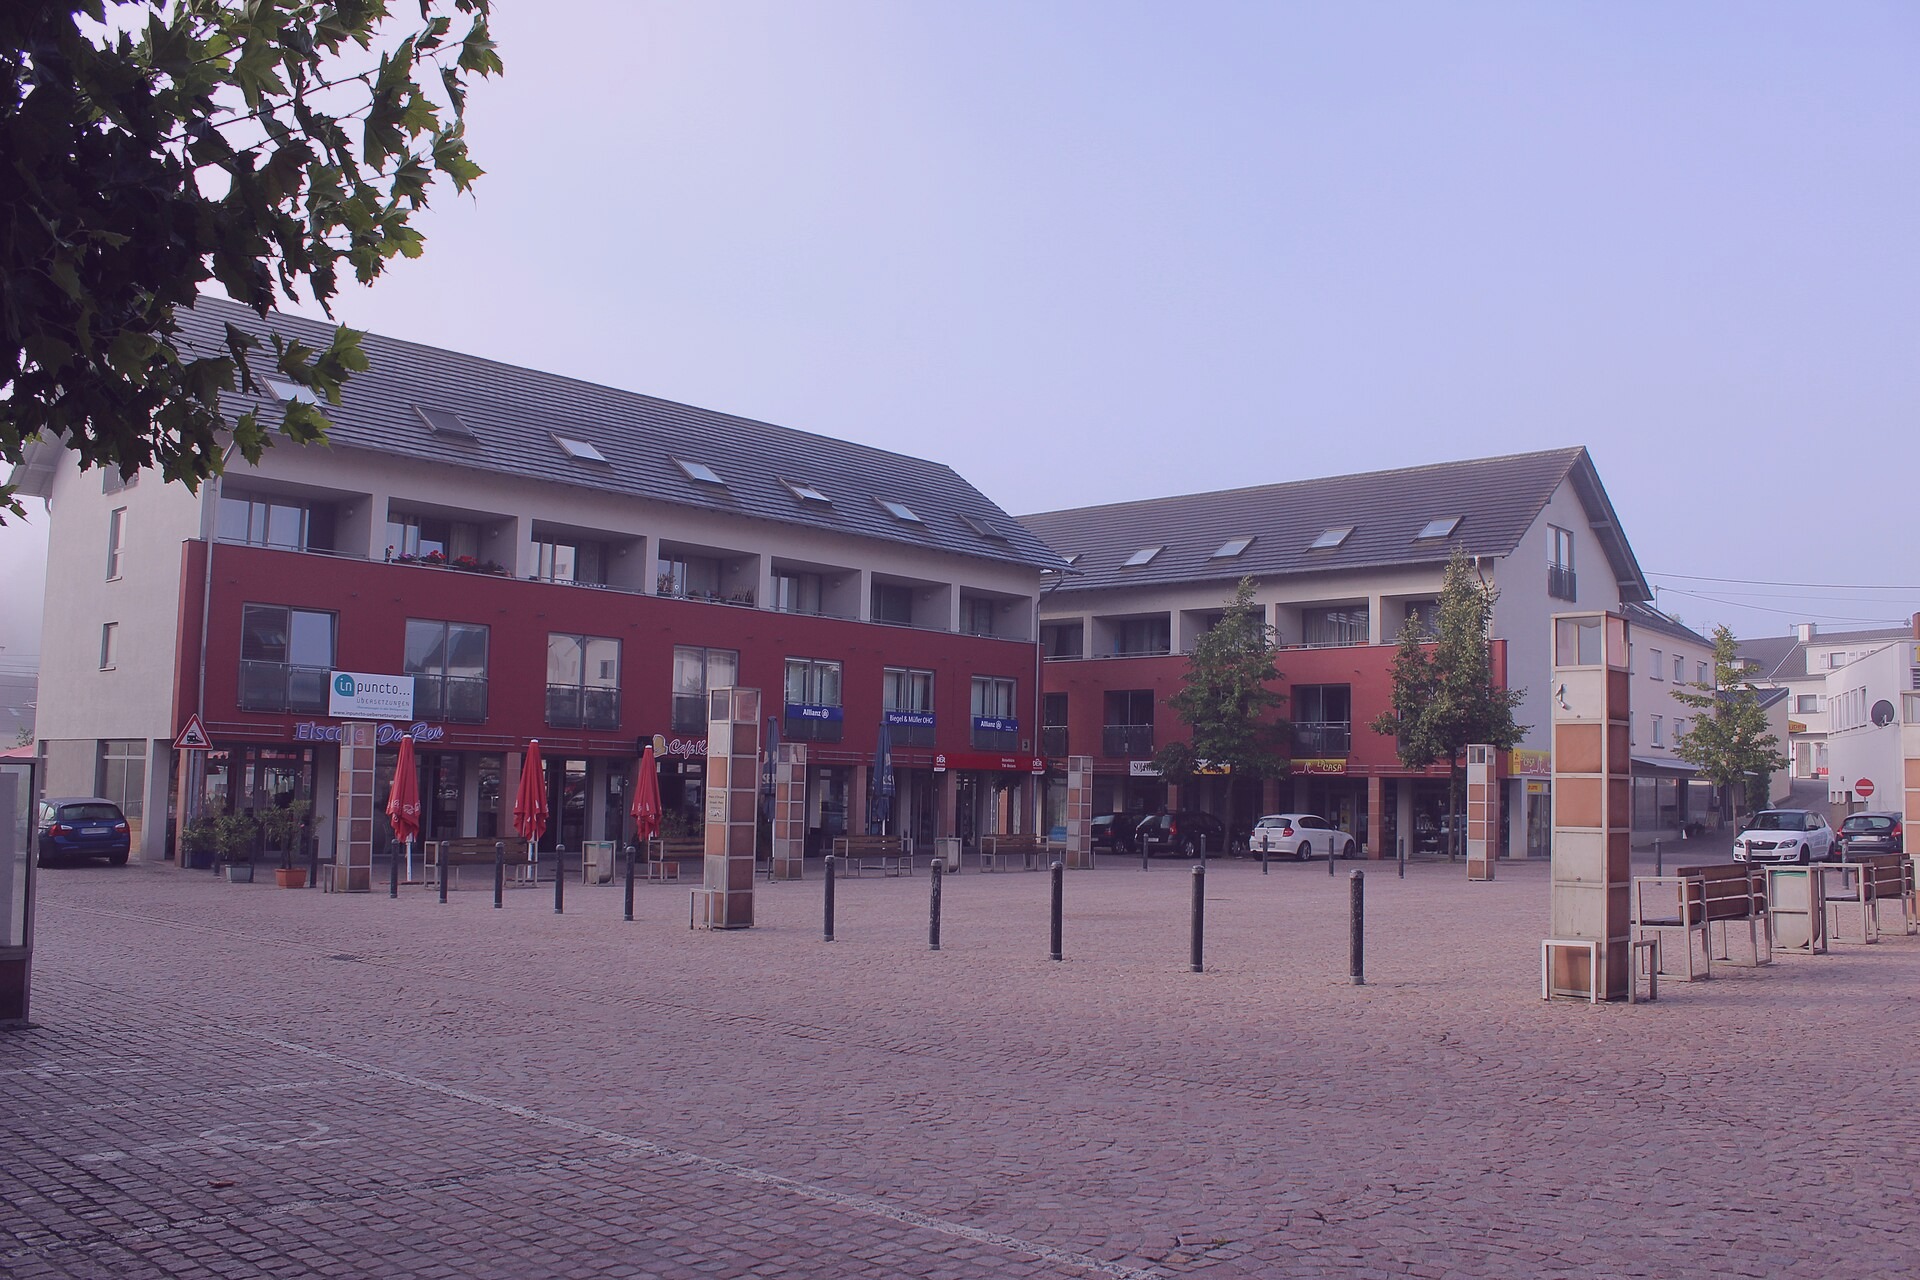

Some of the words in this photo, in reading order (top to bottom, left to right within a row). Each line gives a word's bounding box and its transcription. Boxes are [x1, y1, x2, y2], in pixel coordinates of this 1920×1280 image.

[340, 678, 352, 691] in
[802, 708, 821, 717] Allianz
[981, 720, 996, 728] Allianz
